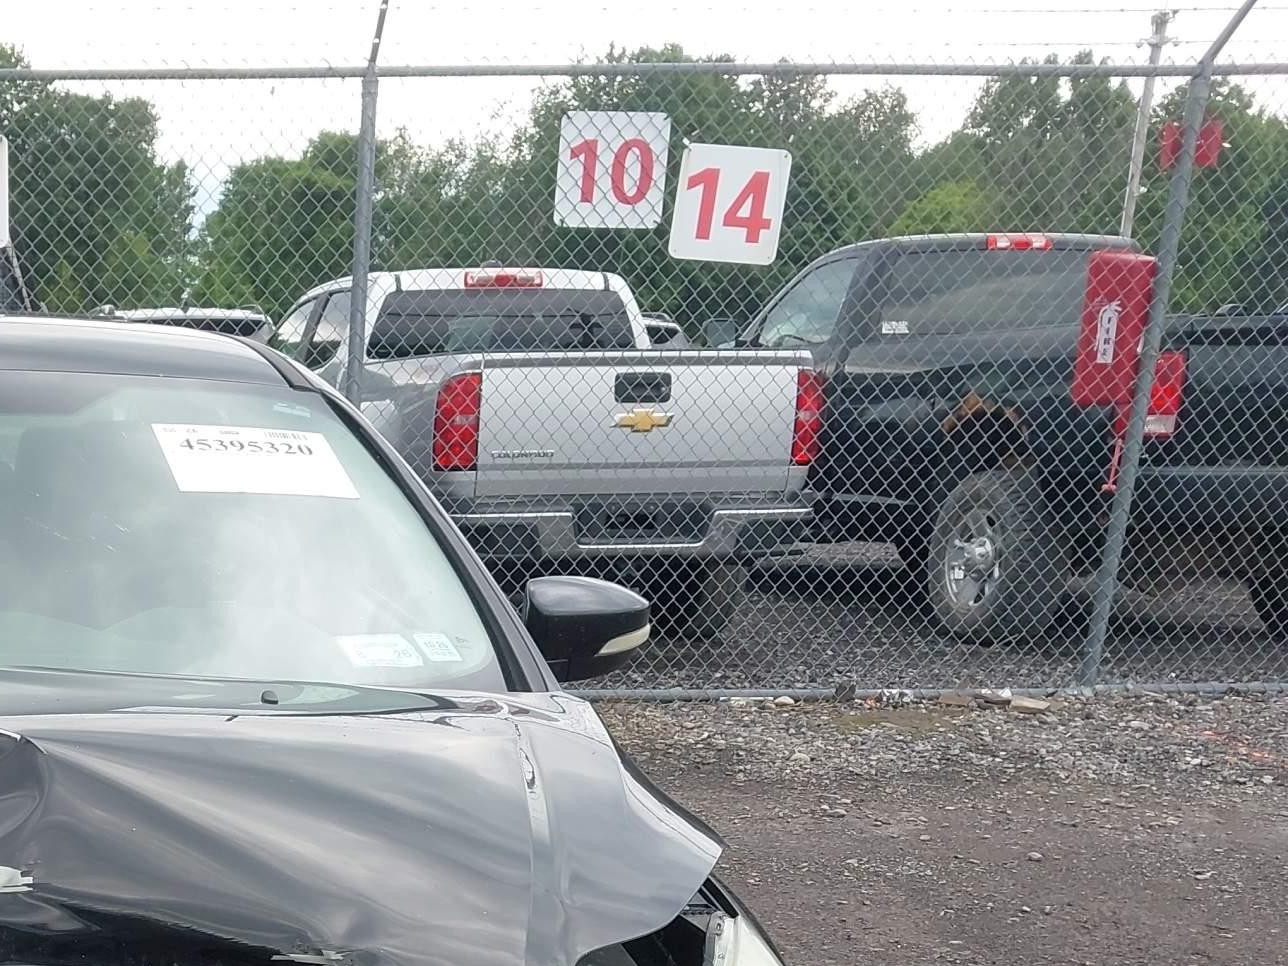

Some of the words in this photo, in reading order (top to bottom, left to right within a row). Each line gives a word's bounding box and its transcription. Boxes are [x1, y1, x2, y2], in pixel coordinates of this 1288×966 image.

[569, 138, 654, 205] 10
[687, 167, 772, 243] 14
[179, 437, 314, 456] 45395320
